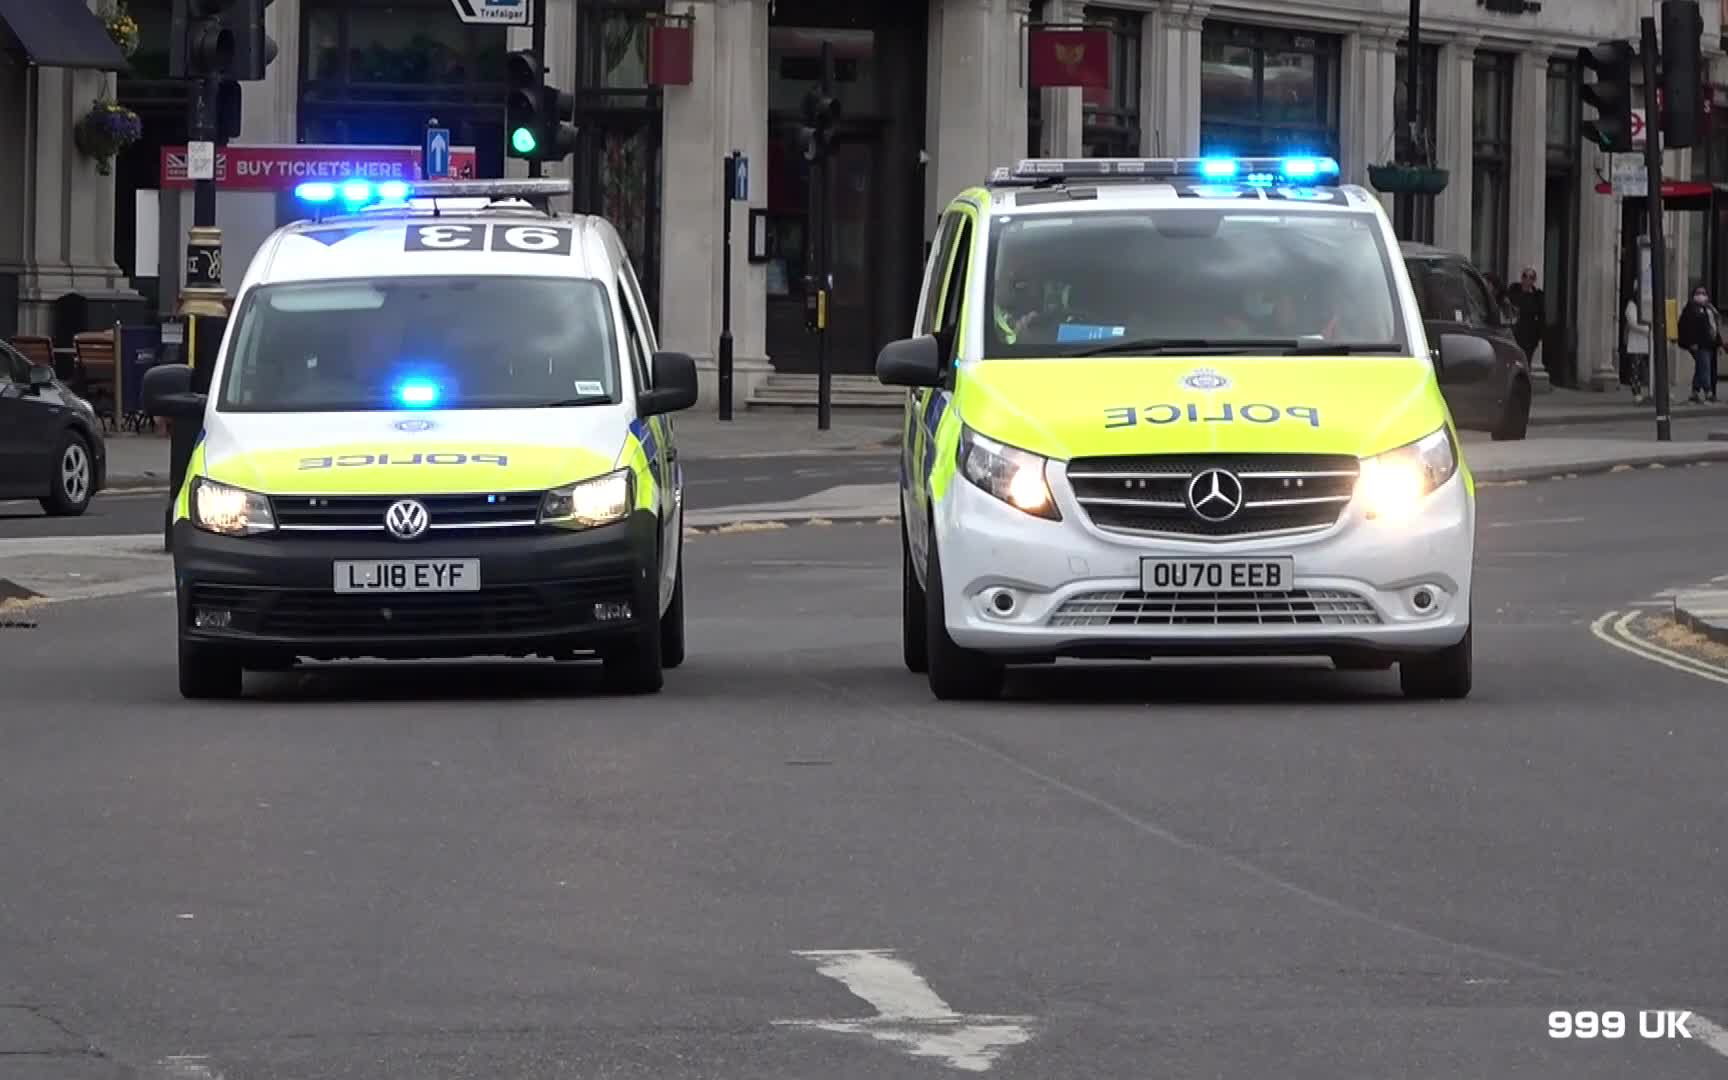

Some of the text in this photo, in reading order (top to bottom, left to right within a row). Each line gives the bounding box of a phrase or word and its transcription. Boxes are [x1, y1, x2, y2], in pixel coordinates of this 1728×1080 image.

[480, 9, 523, 19] Trafalgar
[236, 160, 274, 176] BUY
[276, 160, 350, 176] TICKETS
[355, 162, 402, 176] HERE
[349, 563, 464, 588] LJ18 EYF
[1154, 563, 1281, 587] OU70 EEB
